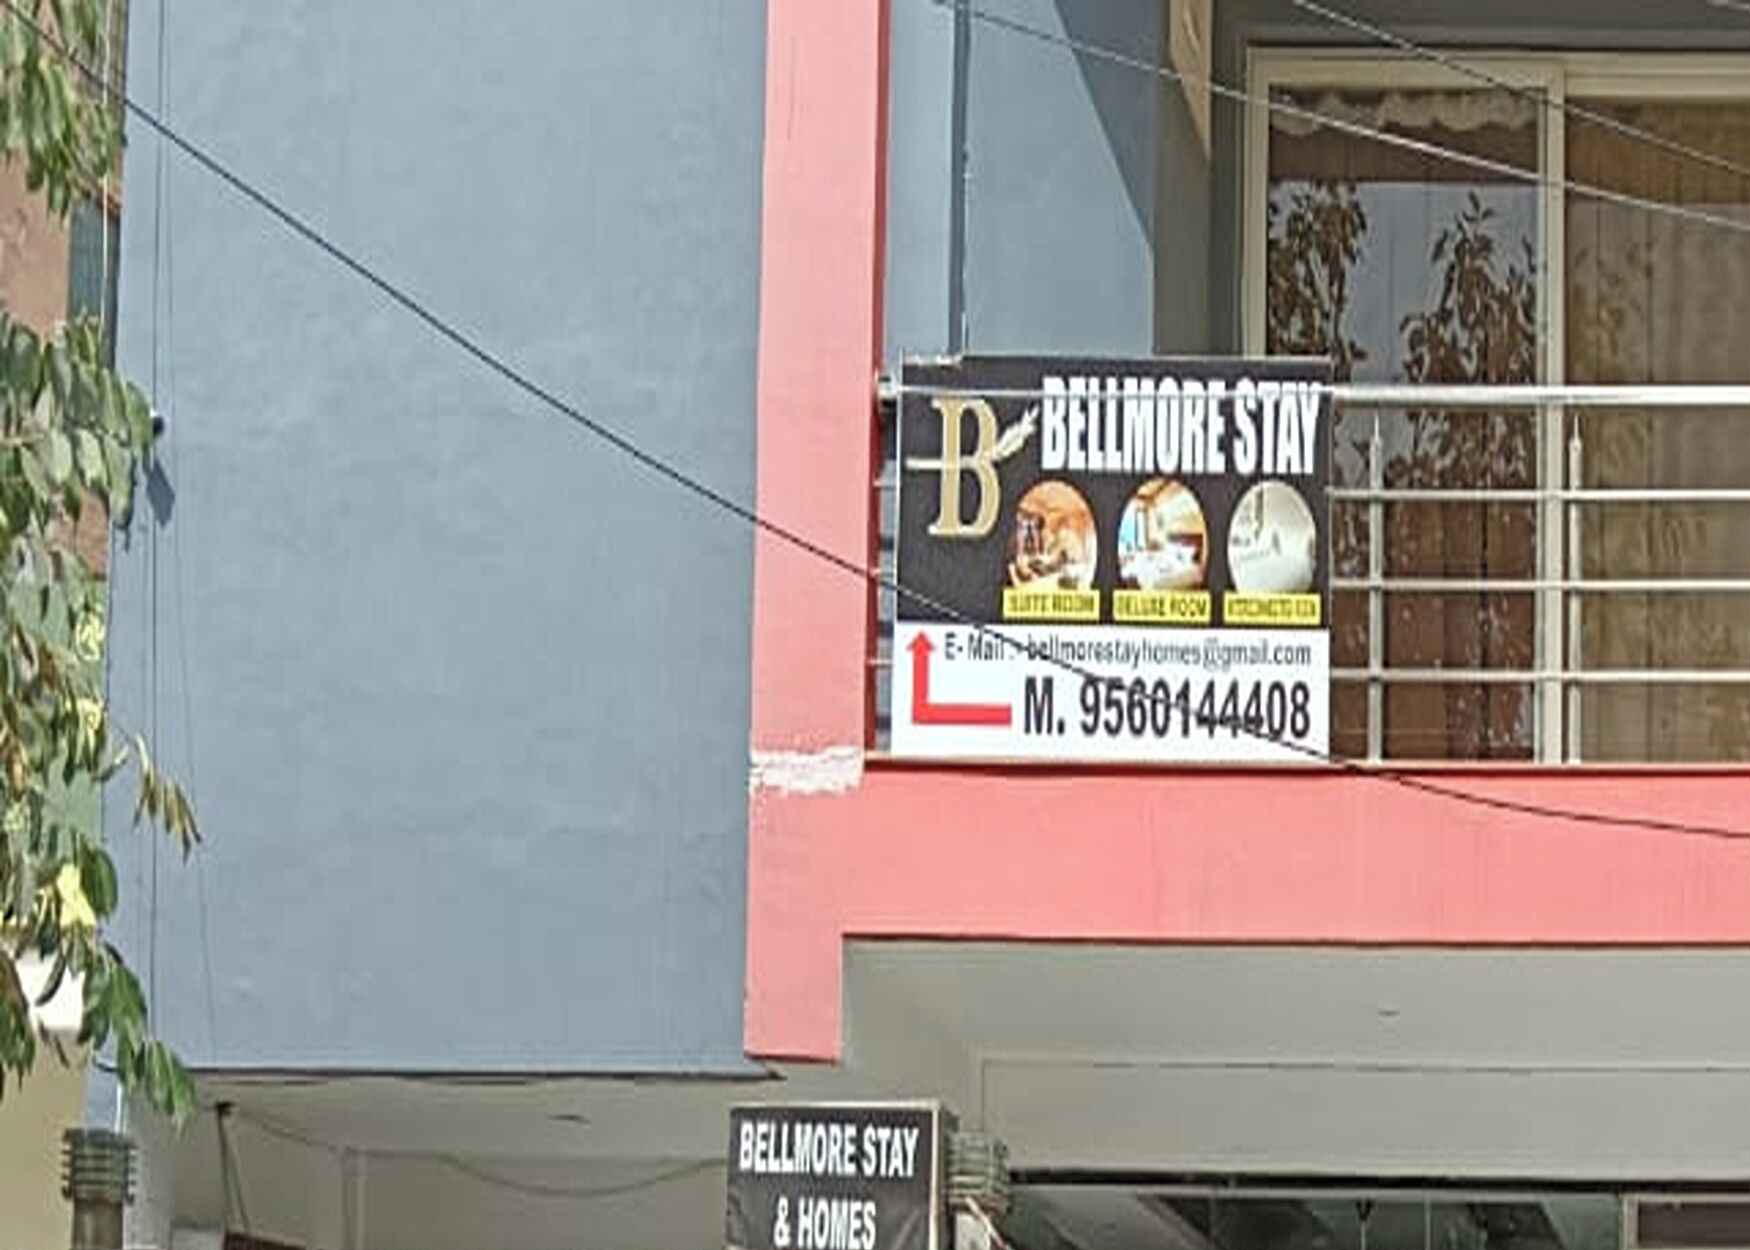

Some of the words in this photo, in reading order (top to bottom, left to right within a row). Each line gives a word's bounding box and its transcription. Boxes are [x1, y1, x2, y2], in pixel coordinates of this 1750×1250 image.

[1041, 376, 1227, 471] BELLMORE
[1233, 378, 1326, 475] STAY
[1080, 676, 1312, 740] 9560144408
[739, 1121, 856, 1176] BELLMORE
[863, 1125, 919, 1177] STAY
[773, 1197, 791, 1248] &
